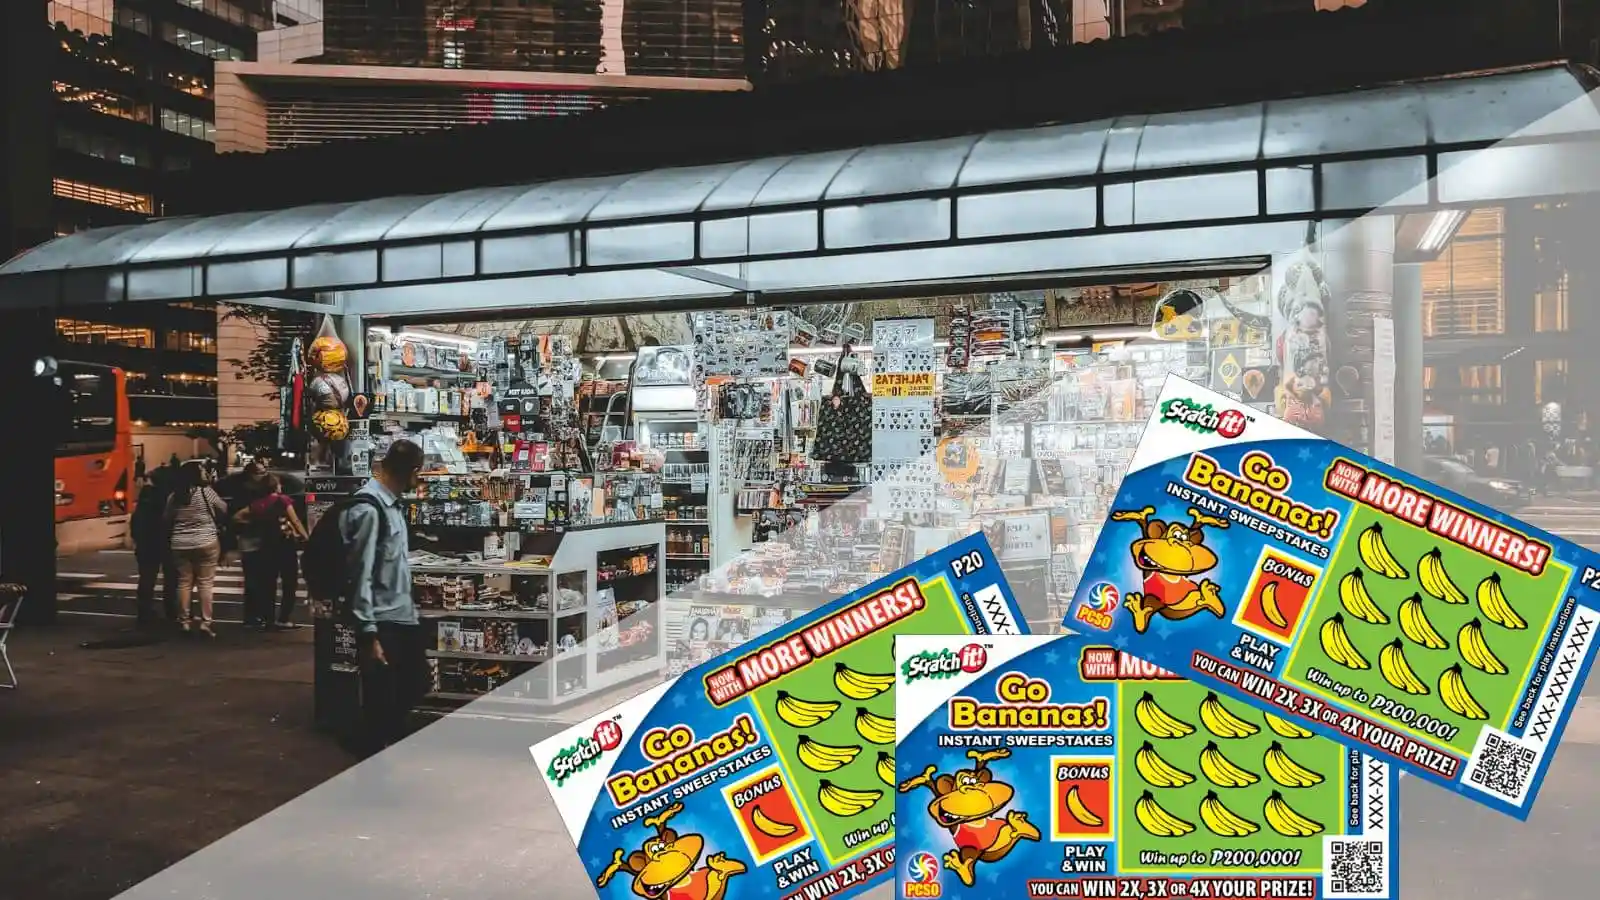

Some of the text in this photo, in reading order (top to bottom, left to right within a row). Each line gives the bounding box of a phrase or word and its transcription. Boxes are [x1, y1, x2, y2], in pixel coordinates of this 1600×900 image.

[1166, 400, 1219, 428] Scratch
[1218, 410, 1245, 434] it!
[1243, 454, 1288, 490] Go
[1330, 473, 1360, 495] WITH
[1337, 464, 1361, 480] NOW
[1187, 456, 1336, 538] Bananas!
[1166, 482, 1330, 559] INSTANT SWEEPSTAKES
[1361, 476, 1549, 573] MORE WINNERS!
[951, 551, 984, 578] P20
[1263, 558, 1314, 587] BONUS
[1581, 566, 1600, 590] P2
[1077, 605, 1112, 629] PCSO
[740, 583, 923, 687] MORE WINNERS!
[1240, 634, 1281, 657] PLAY
[909, 651, 960, 677] Scratch
[962, 643, 985, 667] it!
[1085, 663, 1115, 675] WITH
[1088, 653, 1112, 662] NOW
[1231, 646, 1275, 673] & WIN
[1514, 597, 1576, 728] See back for play instructions
[710, 669, 735, 688] NOW
[713, 681, 743, 702] WITH
[1000, 676, 1047, 702] Go
[1307, 668, 1332, 687] Win
[1333, 684, 1351, 699] up
[1353, 688, 1368, 702] to
[1529, 615, 1594, 742] XXX-XXXX-XXX
[952, 700, 1106, 727] Bananas!
[1194, 654, 1457, 776] YOU CAN WIN 2X, 3X OR 4X YOUR PRIZE!
[553, 737, 601, 779] Scratch
[596, 721, 619, 747] it!
[645, 728, 691, 758] Go
[938, 735, 1113, 746] INSTANT SWEEPSTAKES
[610, 717, 756, 804] Bananas!
[1058, 766, 1110, 780] BONUS
[611, 745, 772, 829] INSTANT SWEEPSTAKES
[734, 775, 782, 808] BONUS
[1350, 749, 1360, 826] See back for pla
[1368, 757, 1384, 829] XXX-XX
[844, 829, 870, 847] Win
[872, 821, 889, 834] up
[773, 847, 811, 875] PLAY
[1065, 846, 1106, 857] PLAY
[1140, 850, 1167, 864] Win
[1169, 854, 1187, 867] up
[1191, 852, 1206, 864] to
[788, 861, 820, 883] WIN
[803, 875, 840, 900] WIN
[839, 863, 865, 887] 2X,
[862, 855, 887, 875] 3X
[1074, 860, 1106, 872] WIN
[906, 882, 940, 897] PCSO
[1031, 880, 1313, 899] YOU CAN WIN 2X, 3X OR 4X YOUR PRIZE!
